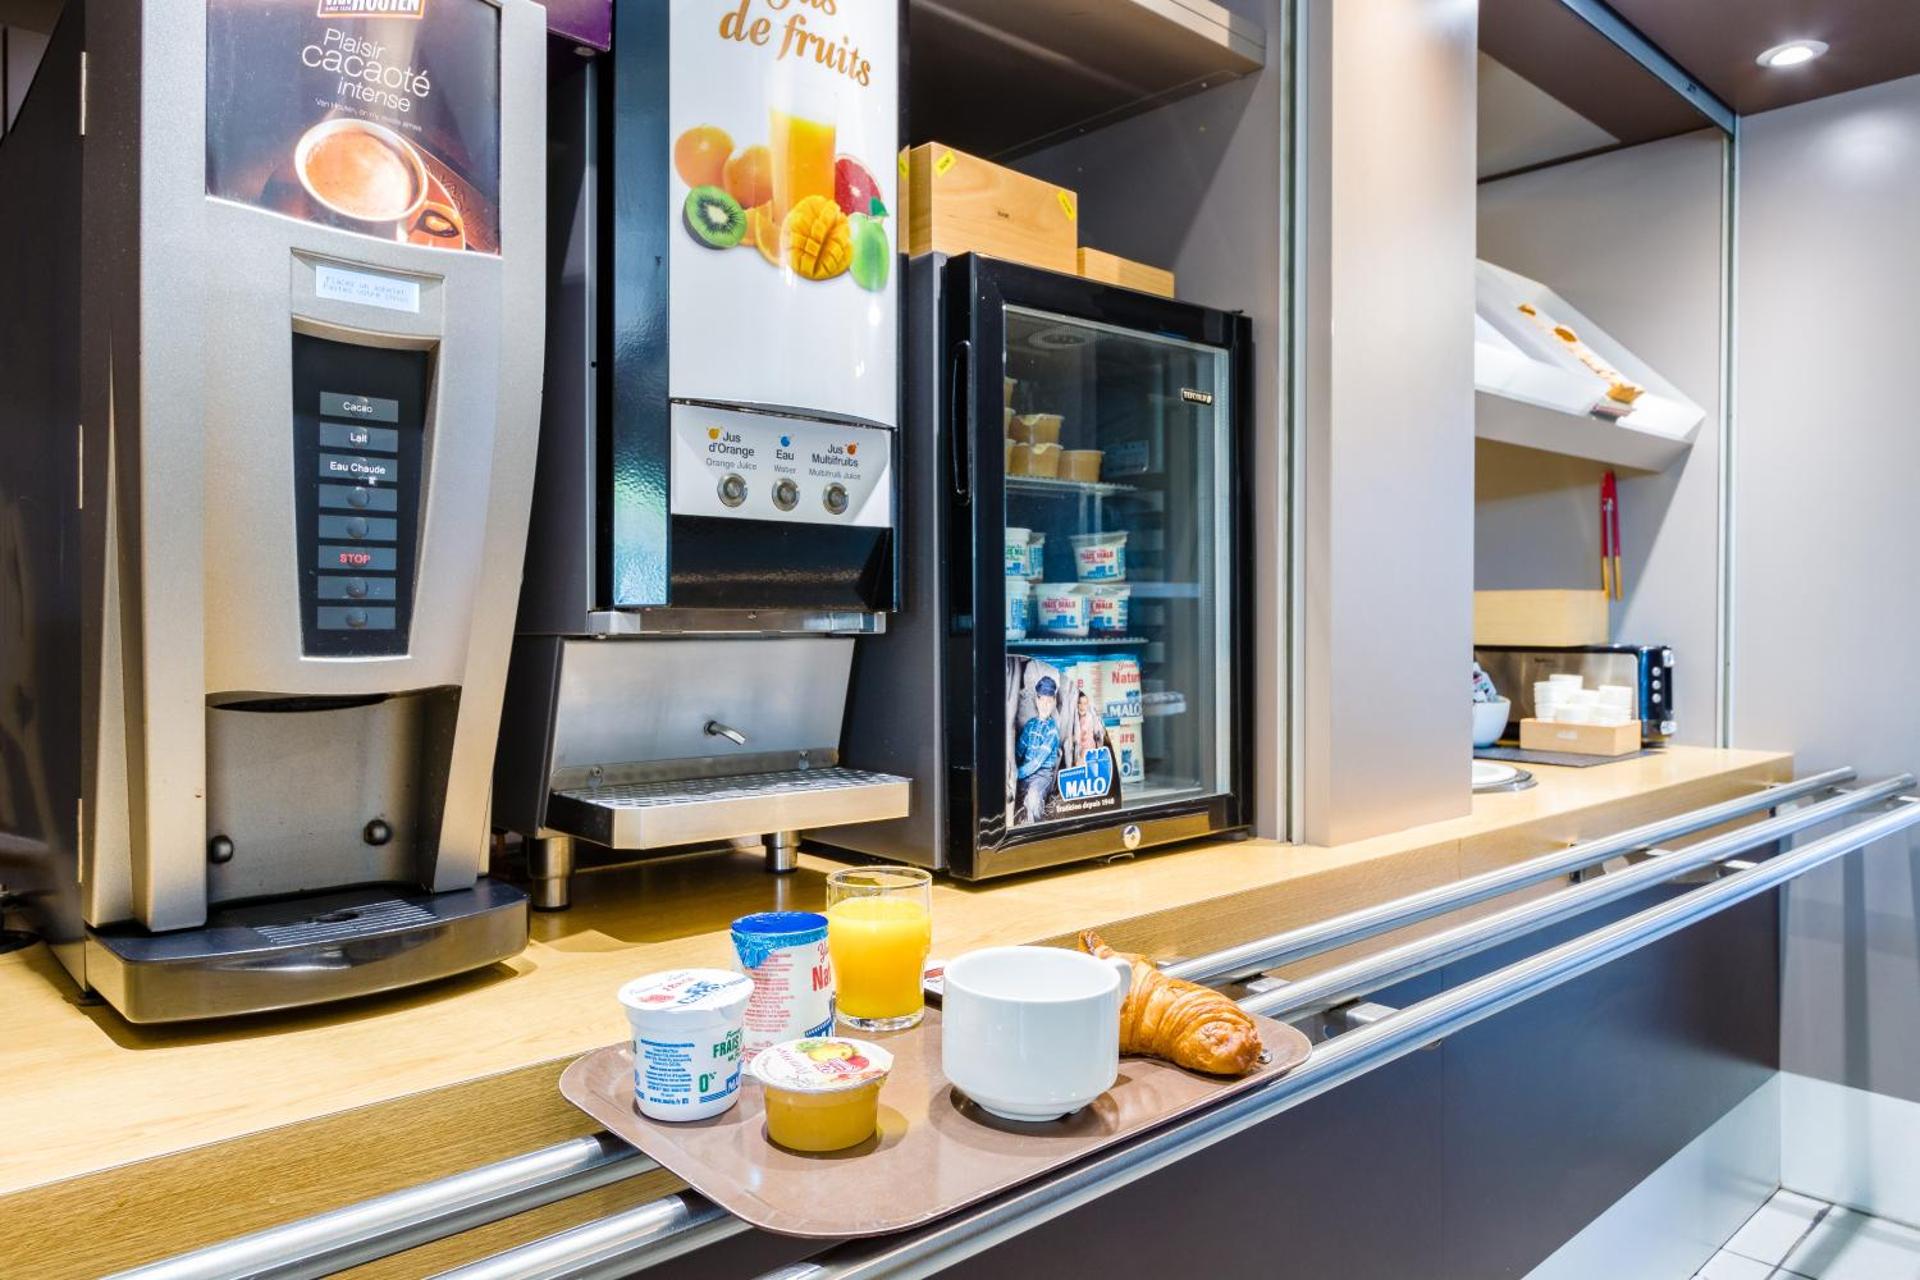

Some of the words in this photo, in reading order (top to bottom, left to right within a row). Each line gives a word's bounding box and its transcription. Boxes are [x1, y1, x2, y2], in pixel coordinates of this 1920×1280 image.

[324, 28, 386, 59] Plaisir
[719, 0, 771, 46] de
[776, 13, 871, 87] fruits
[302, 45, 431, 97] cacaoté
[337, 77, 411, 112] intense
[343, 402, 373, 413] Cacao
[350, 432, 367, 443] Lait
[722, 432, 742, 443] Jus
[708, 442, 755, 458] d'Orange
[776, 449, 795, 460] Eau
[827, 443, 843, 454] Jus
[706, 457, 735, 470] Orange
[737, 460, 758, 471] Juice
[811, 453, 858, 467] Multifruits
[330, 461, 349, 472] Eau
[350, 462, 386, 475] Chaude
[774, 464, 796, 474] Water
[339, 553, 370, 565] STOP
[1065, 777, 1107, 798] MALO
